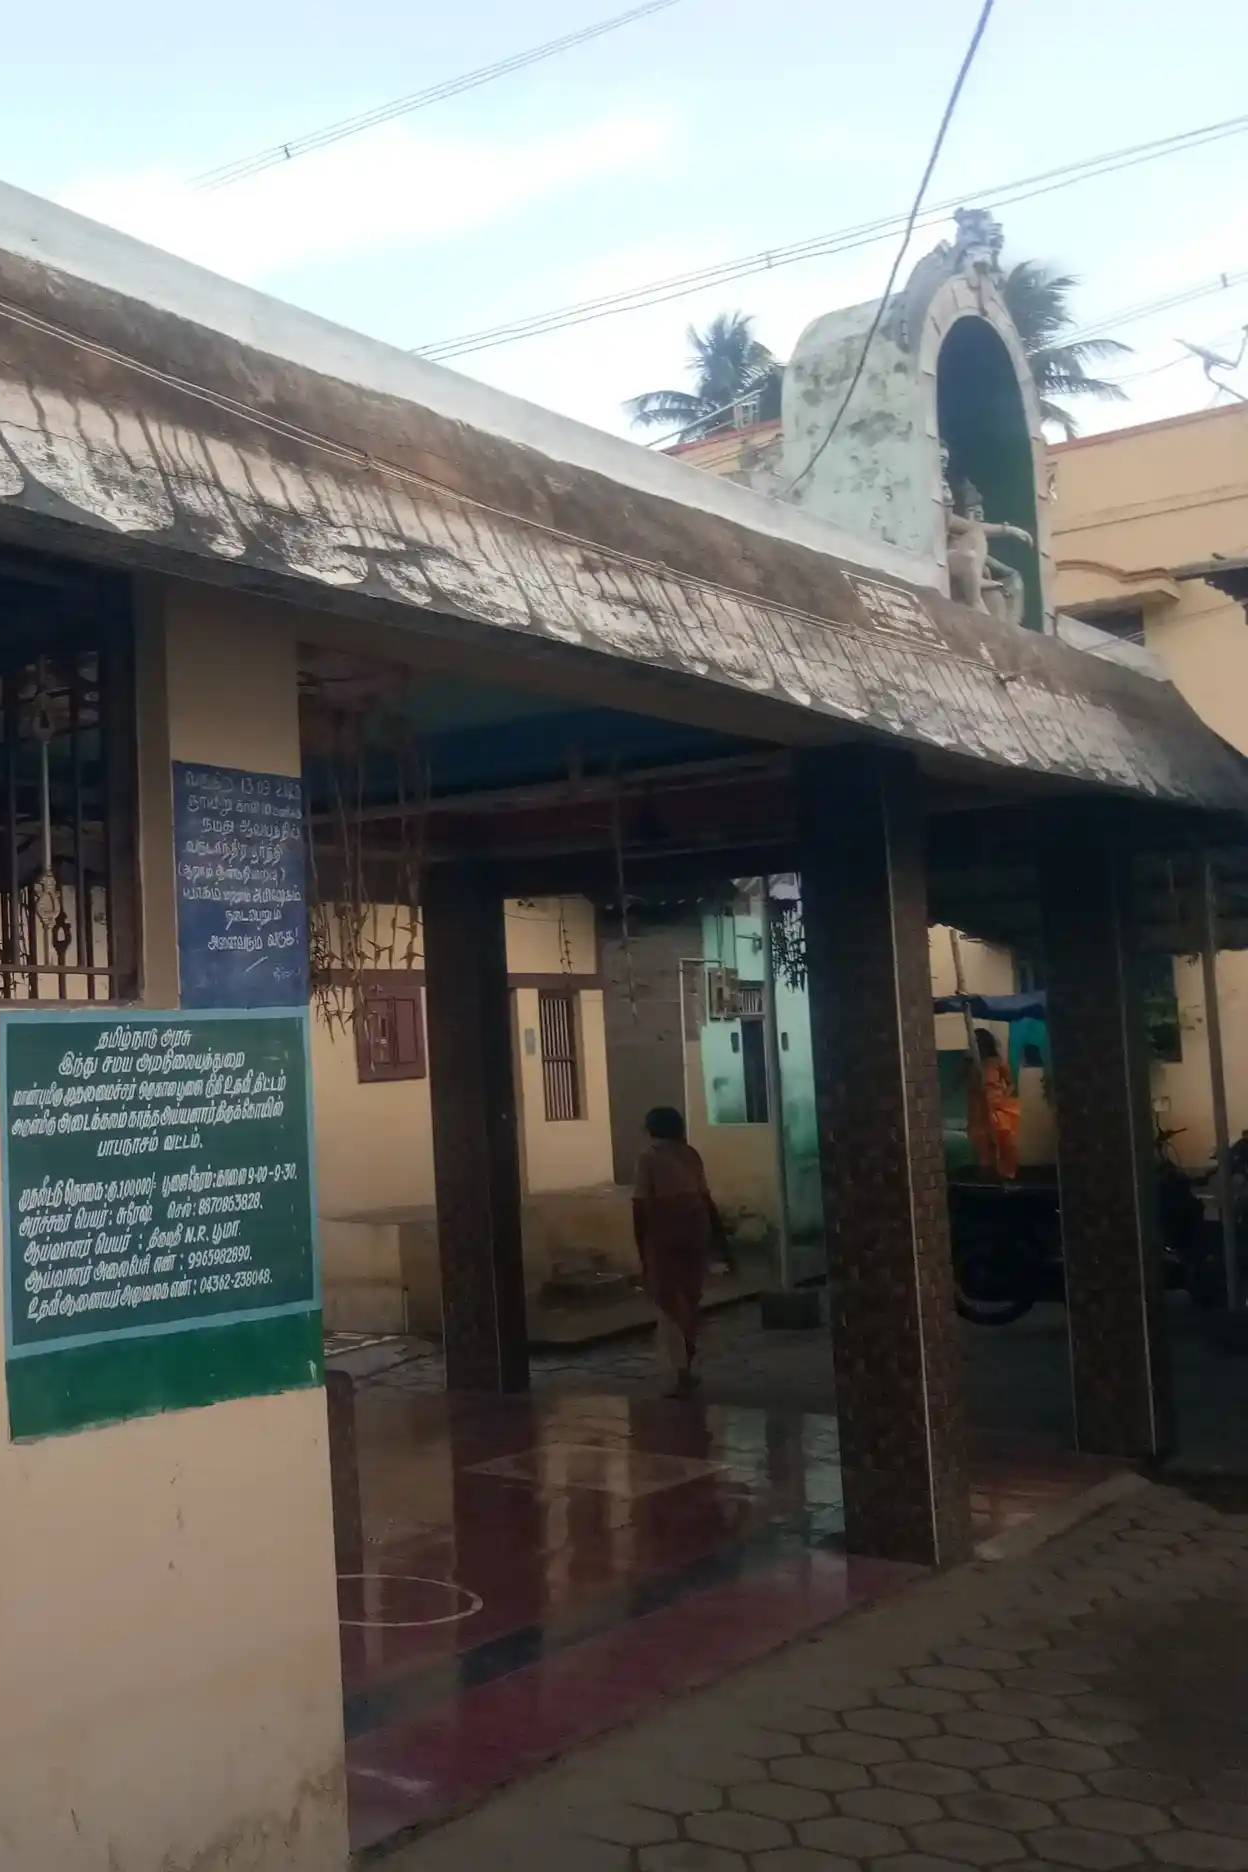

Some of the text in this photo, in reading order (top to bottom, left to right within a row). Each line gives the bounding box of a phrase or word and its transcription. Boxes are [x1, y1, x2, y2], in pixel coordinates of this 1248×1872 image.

[201, 817, 301, 842] நமது ஆலயத்தில்
[94, 1024, 192, 1051] தமிழ்நாடு அரசு
[58, 1047, 245, 1080] இந்து சமய அறநிலையத்துறை
[13, 1081, 63, 1110] மாண்புமிகு
[223, 1069, 253, 1098] உதவி
[251, 1068, 287, 1096] திட்டம்
[11, 1108, 56, 1138] அருள்மிகு
[57, 1103, 127, 1134] அடைக்கலம்
[97, 1125, 203, 1158] பாபநாசம் வட்டம்.
[18, 1174, 64, 1212] முதலீட்டு
[18, 1207, 72, 1239] அர்ச்சகர்
[116, 1199, 153, 1226] சுரேஷ்
[23, 1231, 93, 1267] ஆய்வாளர்
[94, 1226, 133, 1256] பெயர்
[146, 1223, 184, 1252] திருமதி
[24, 1257, 93, 1294] ஆய்வாளர்
[93, 1253, 151, 1281] அலைபேசி
[153, 1249, 177, 1273] எண்
